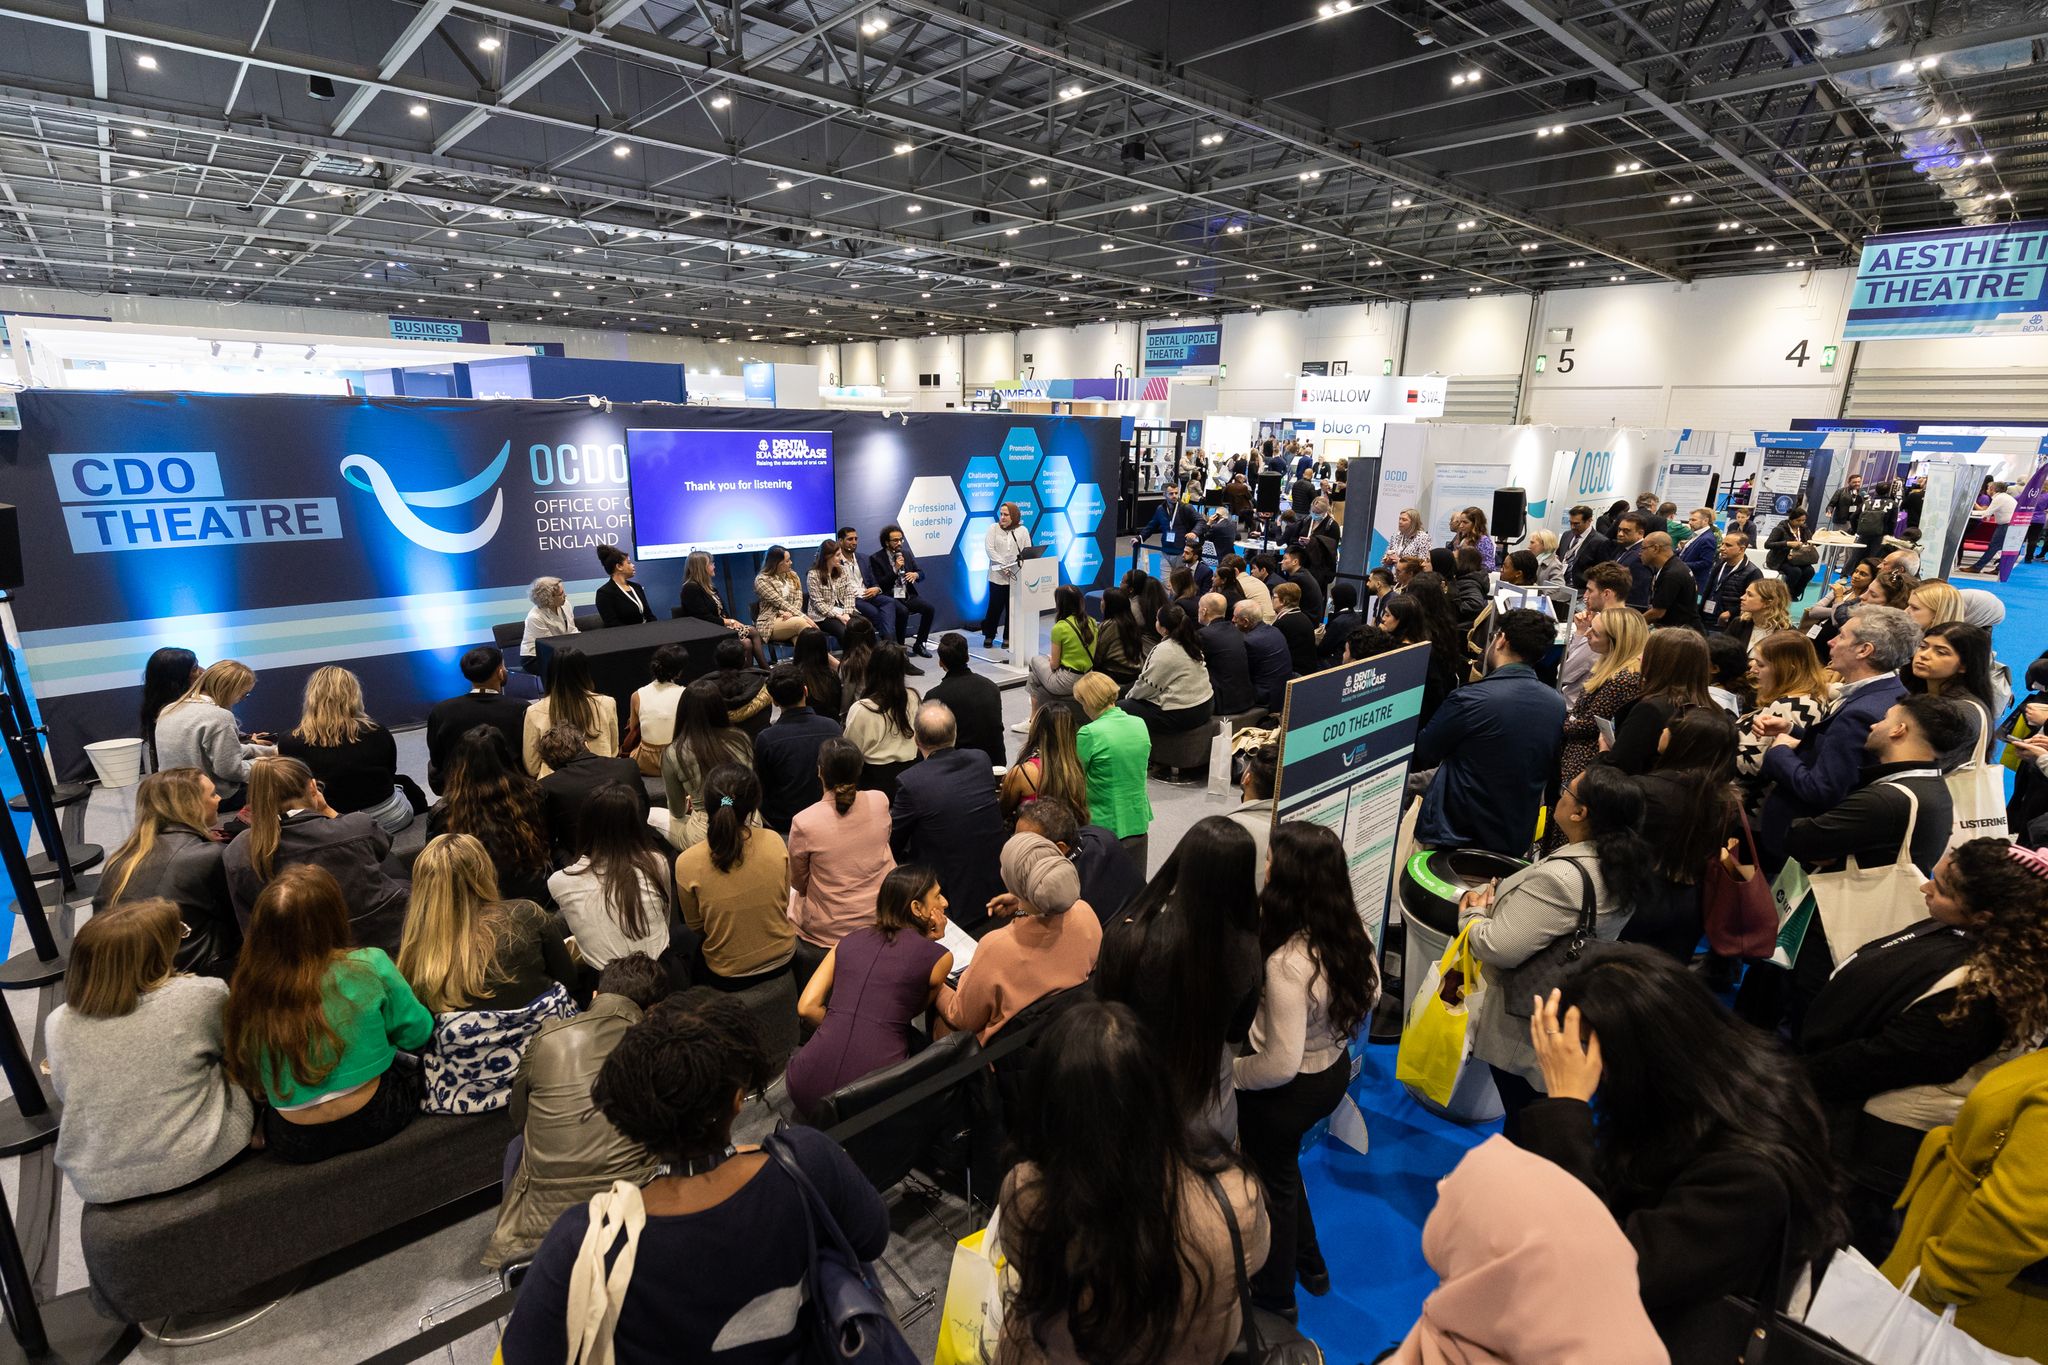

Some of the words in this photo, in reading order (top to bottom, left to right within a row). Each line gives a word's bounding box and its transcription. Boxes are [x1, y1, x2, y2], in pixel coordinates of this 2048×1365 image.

[1869, 234, 2048, 272] AESTHETI
[1865, 272, 2028, 304] THEATRE
[394, 322, 458, 335] BUSINESS
[1149, 336, 1180, 346] DENTAL
[1182, 332, 1217, 344] UPDATE
[1148, 348, 1184, 359] THEATRE
[1785, 340, 1810, 368] 4
[1557, 348, 1575, 373] 5
[1028, 366, 1034, 381] 7
[1115, 363, 1122, 379] 6
[829, 372, 835, 385] 8
[1309, 389, 1371, 402] SWALLOW
[772, 439, 808, 450] DENTAL
[1009, 444, 1034, 453] Promoting
[772, 449, 827, 459] SHOWCASE
[529, 444, 630, 486] OCDO
[72, 457, 196, 497] CDO
[968, 472, 998, 480] Challenging
[1385, 470, 1407, 481] OCDO
[684, 481, 716, 491] Thank
[718, 482, 736, 492] you
[738, 480, 751, 489] for
[754, 479, 792, 490] listening
[535, 498, 594, 514] OFFICE
[597, 497, 620, 512] OF
[909, 503, 956, 513] Professional
[82, 503, 323, 546] THEATRE
[537, 516, 602, 533] DENTAL
[912, 516, 953, 526] leadership
[539, 532, 619, 551] ENGLAND
[925, 531, 941, 539] role
[1323, 720, 1346, 742] CDO
[1349, 703, 1393, 733] THEATRE
[1959, 816, 2007, 829] LISTERINE
